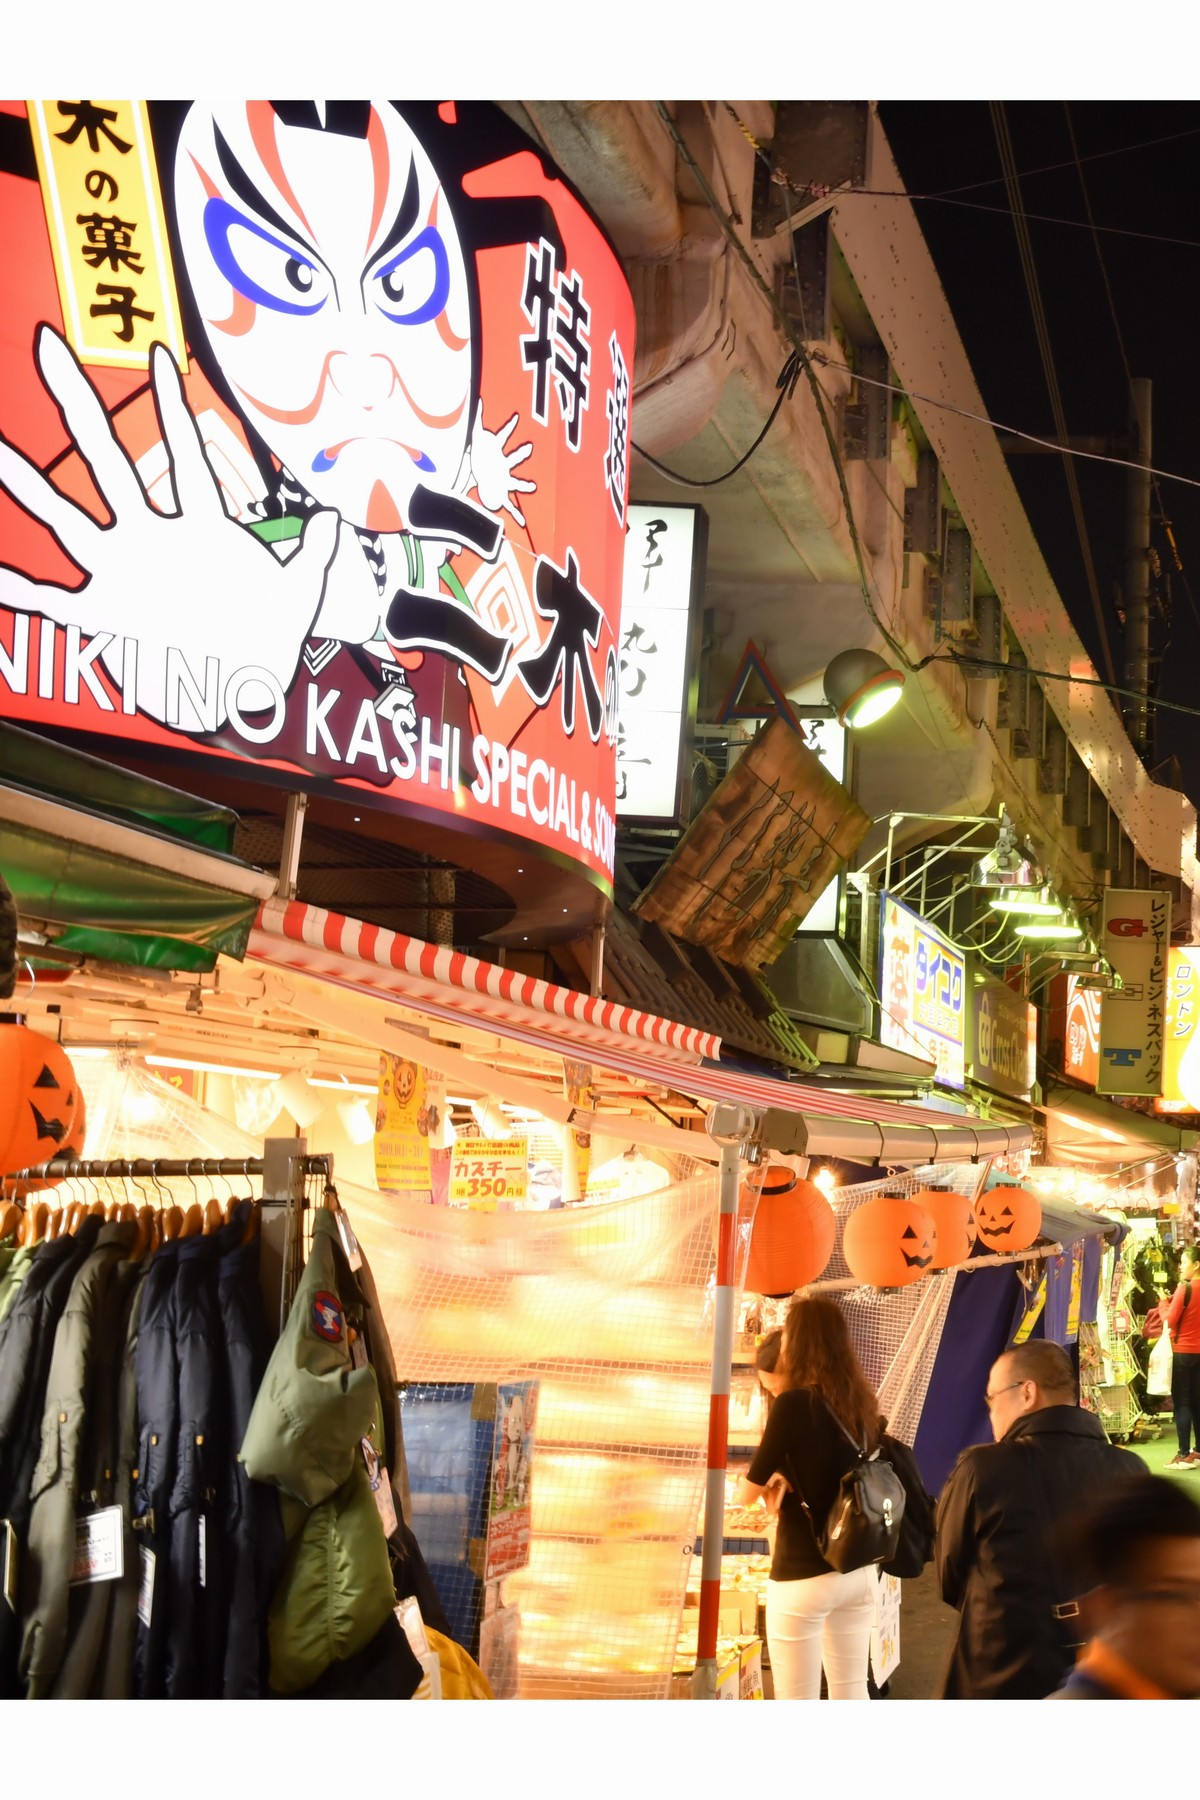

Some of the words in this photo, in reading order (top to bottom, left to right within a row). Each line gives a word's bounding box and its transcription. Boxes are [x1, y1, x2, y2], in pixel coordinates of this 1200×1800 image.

[0, 605, 138, 716] NIKI
[165, 646, 286, 745] NO
[306, 682, 460, 793] KASHI
[471, 733, 580, 841] SPECIAL
[580, 790, 592, 851] &
